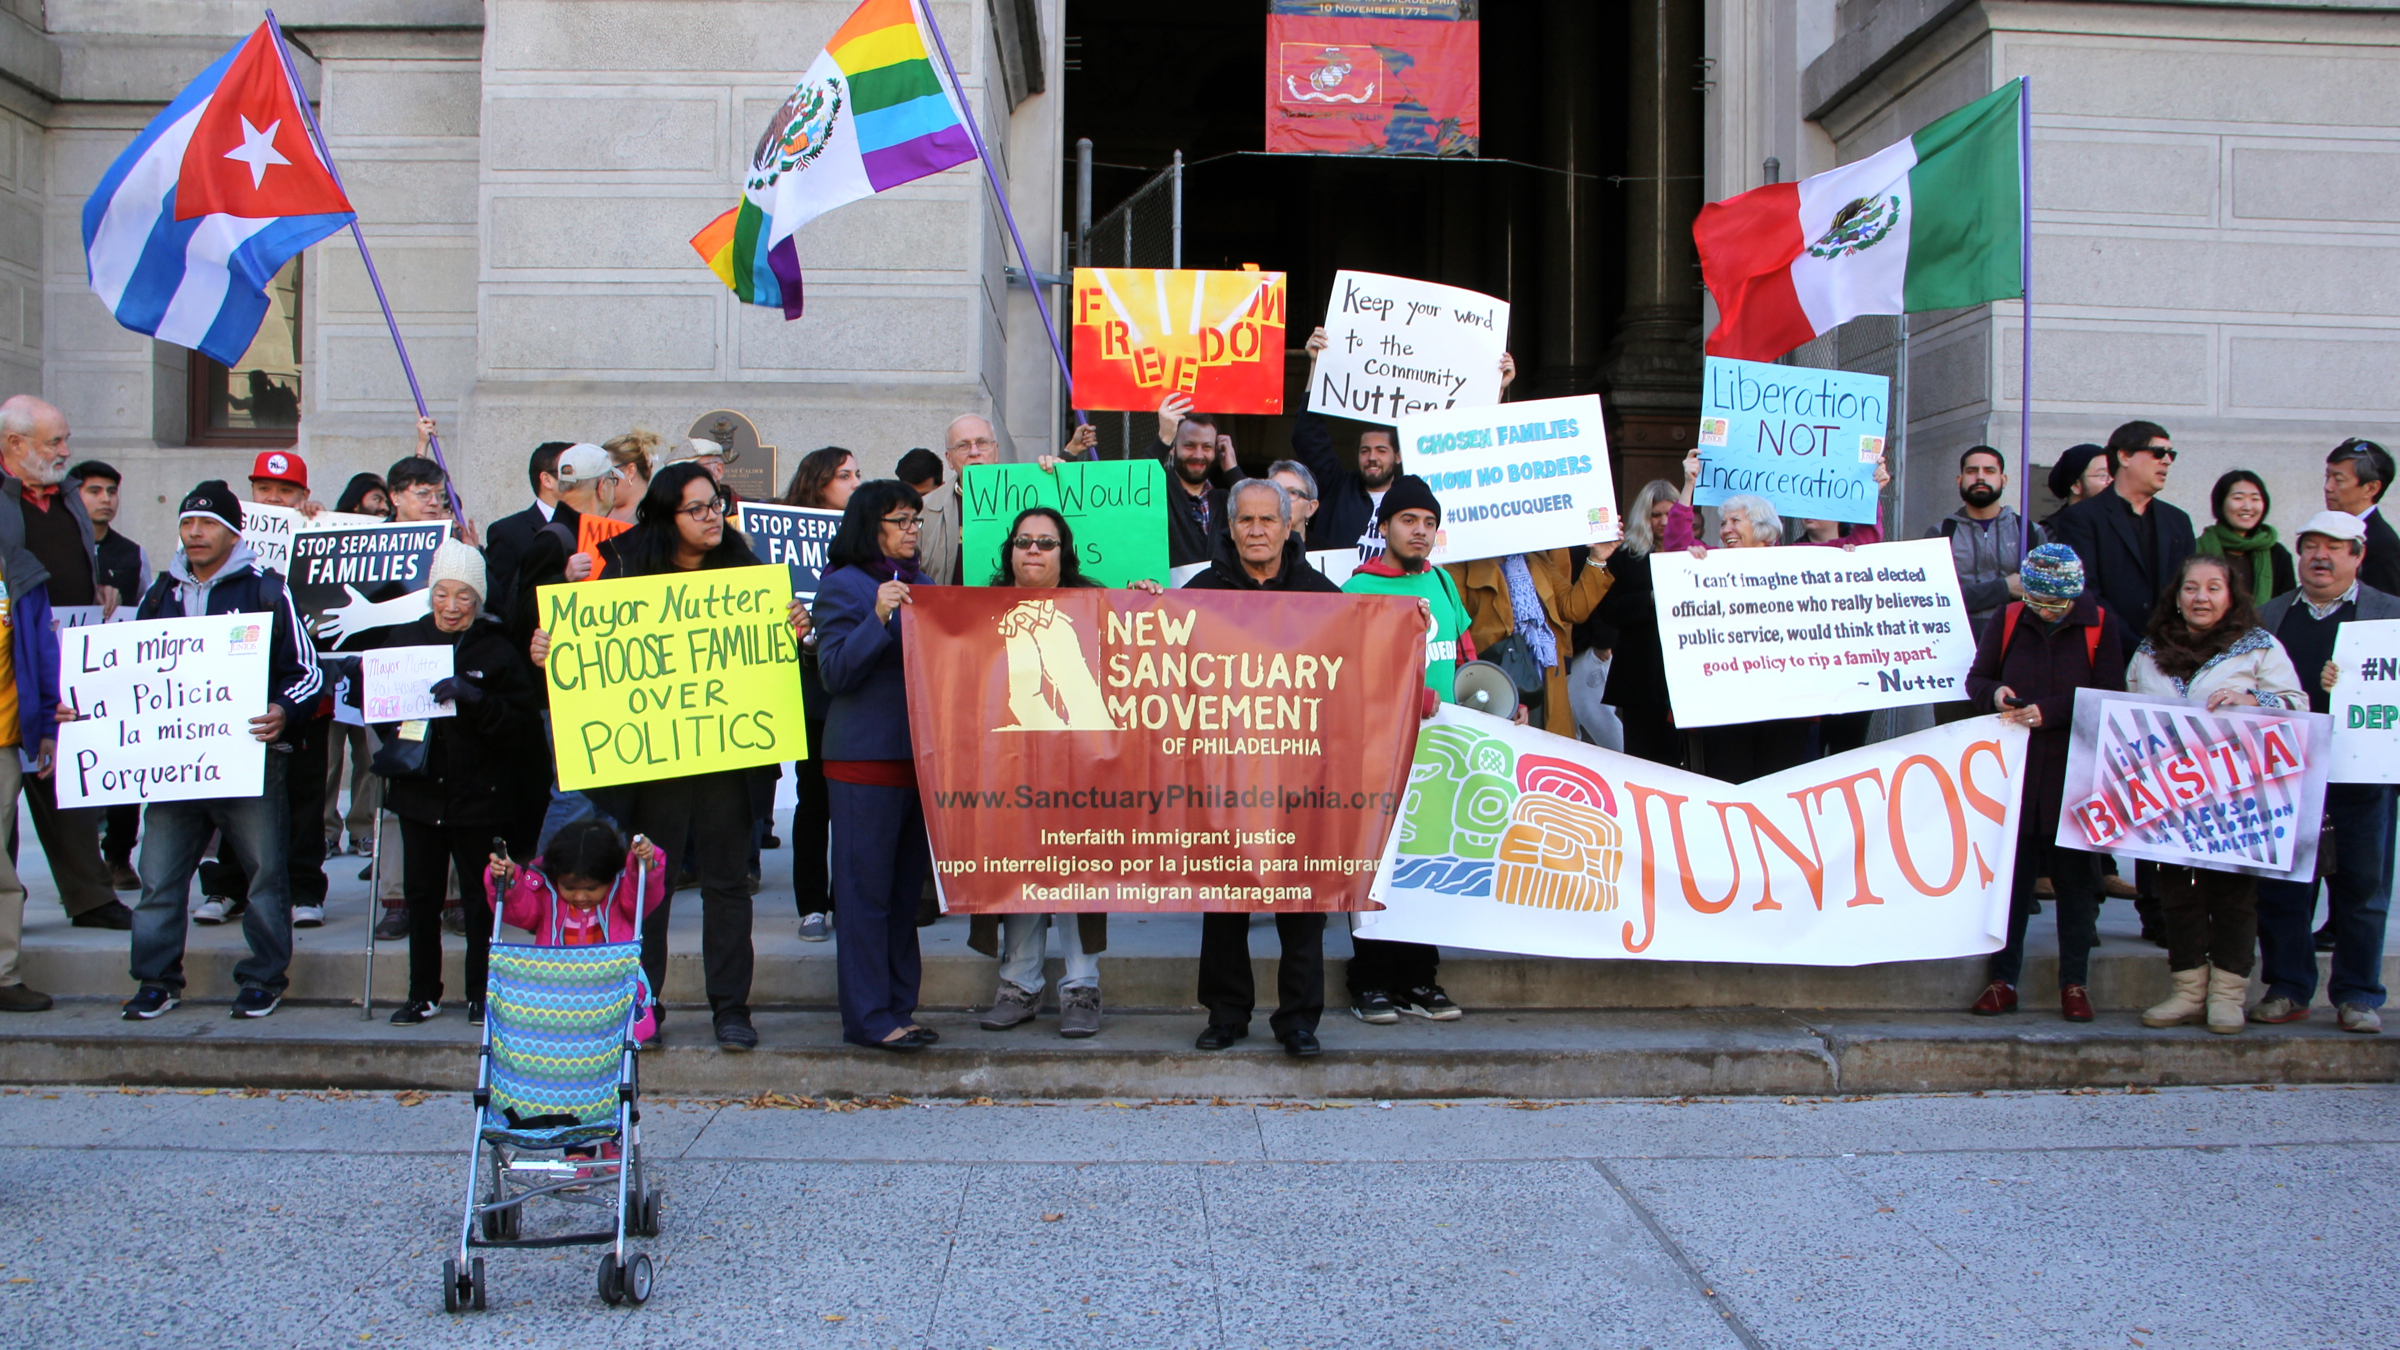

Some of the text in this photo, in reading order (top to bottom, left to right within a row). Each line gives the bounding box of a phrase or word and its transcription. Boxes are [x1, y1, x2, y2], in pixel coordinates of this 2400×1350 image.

[1319, 3, 1332, 13] 10
[1400, 7, 1428, 16] 1775
[1343, 278, 1494, 331] Keep your word
[1080, 284, 1285, 392] FREEDOM
[1345, 328, 1414, 357] to the
[1714, 365, 1883, 424] Liberation
[1417, 418, 1579, 455] CHOSEN FAMILIES
[1758, 419, 1840, 457] NOT
[1477, 466, 1503, 487] NO
[1508, 455, 1592, 483] BORDERS
[1695, 458, 1864, 500] Incarceration
[968, 464, 1151, 516] Who Would
[1446, 494, 1573, 524] #UNDOCUQUEER
[750, 514, 842, 539] STOP SEPA
[297, 531, 437, 557] STOP SEPARATING
[308, 554, 419, 585] FAMILIES
[1702, 572, 1738, 588] can't
[1740, 571, 1798, 590] imagine
[1801, 570, 1831, 585] that
[1834, 571, 1843, 583] a
[1845, 567, 1873, 582] real
[1877, 567, 1926, 582] elected
[549, 584, 775, 637] Mayor Nutter,
[1672, 592, 1951, 618] official, someone who really believes in
[1107, 608, 1196, 647] NEW
[1677, 619, 1951, 650] public service, would think that it was
[83, 631, 204, 673] La migra
[551, 620, 800, 691] CHOOSE FAMILIES
[1703, 657, 1739, 677] good
[1742, 654, 1786, 674] policy
[1789, 655, 1805, 667] to
[1808, 652, 1830, 670] rip
[1833, 655, 1842, 666] a
[1844, 649, 1890, 667] family
[369, 658, 400, 679] Mayor
[1107, 652, 1343, 691] SANCTUARY
[1877, 668, 1955, 692] Nutter
[2361, 657, 2400, 681] #N
[70, 686, 107, 721] La
[629, 679, 728, 714] OVER
[1108, 693, 1323, 733] MOVEMENT
[2347, 704, 2400, 730] DEP
[120, 718, 232, 746] la misma
[581, 710, 776, 774] POLITICS
[1162, 737, 1322, 756] OF PHILADELPHIA
[77, 749, 221, 798] Porquería
[2076, 730, 2298, 843] BASTA
[934, 784, 1397, 815] www.SanctuaryPhiladelphia.org
[2184, 797, 2256, 827] ABUSO
[1040, 828, 1296, 849] Interfaith immigrant justice
[1622, 739, 2008, 954] JUNTOS
[983, 856, 1114, 876] interreligioso
[1120, 859, 1153, 875] por
[1159, 855, 1176, 872] la
[1181, 855, 1253, 876] justicia
[1259, 858, 1298, 876] para
[1022, 883, 1312, 904] Keadilan imigran antaragama
